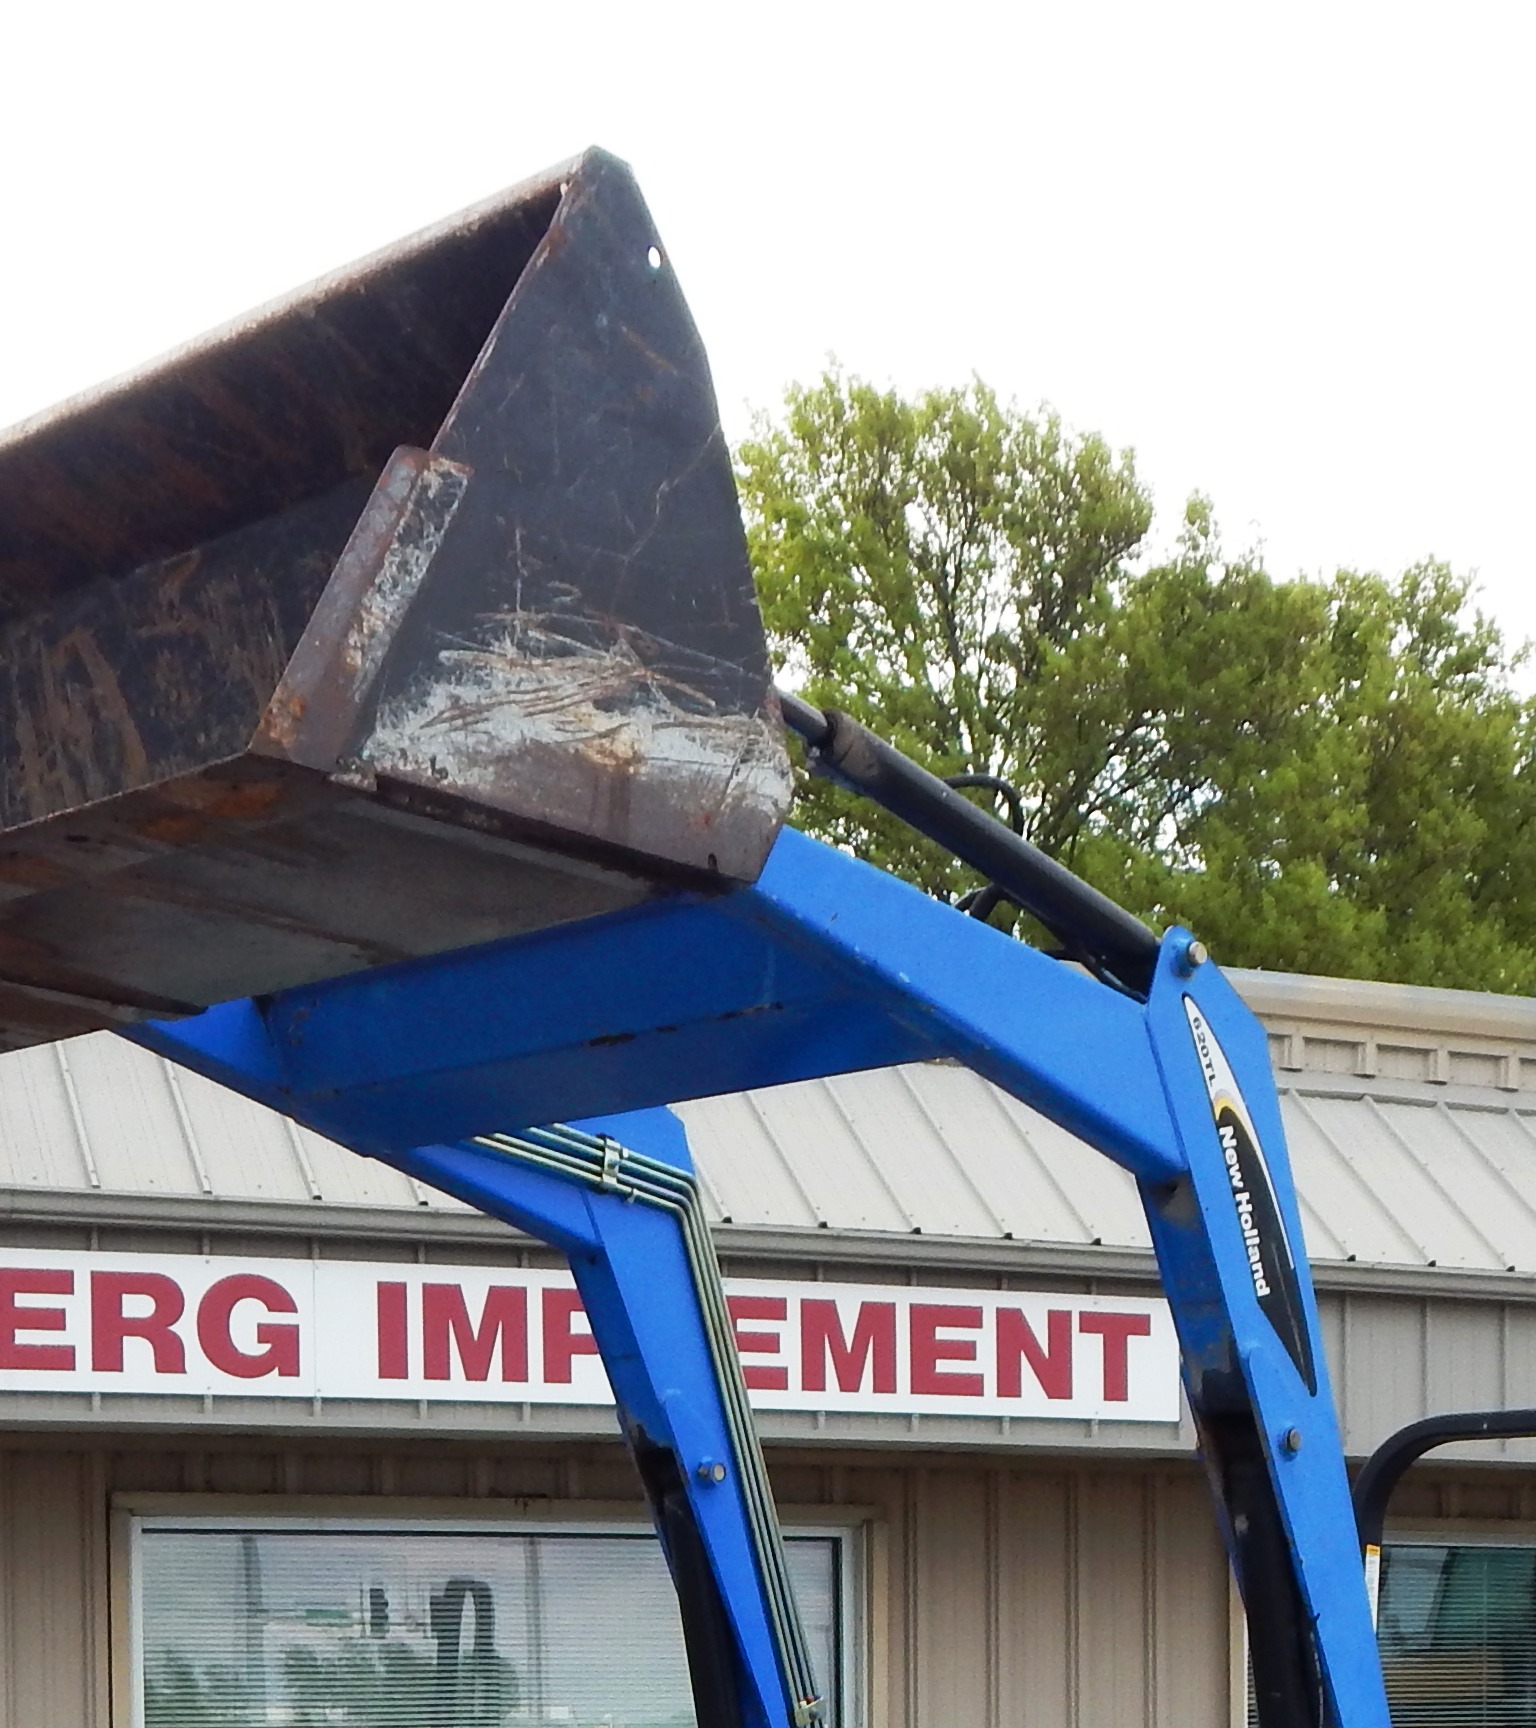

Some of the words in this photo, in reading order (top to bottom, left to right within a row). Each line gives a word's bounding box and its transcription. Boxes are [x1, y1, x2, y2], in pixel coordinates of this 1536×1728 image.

[1191, 1016, 1217, 1088] 620TL
[1218, 1125, 1244, 1189] New
[1235, 1190, 1271, 1298] Holland
[375, 1280, 1151, 1402] IMPEMENT
